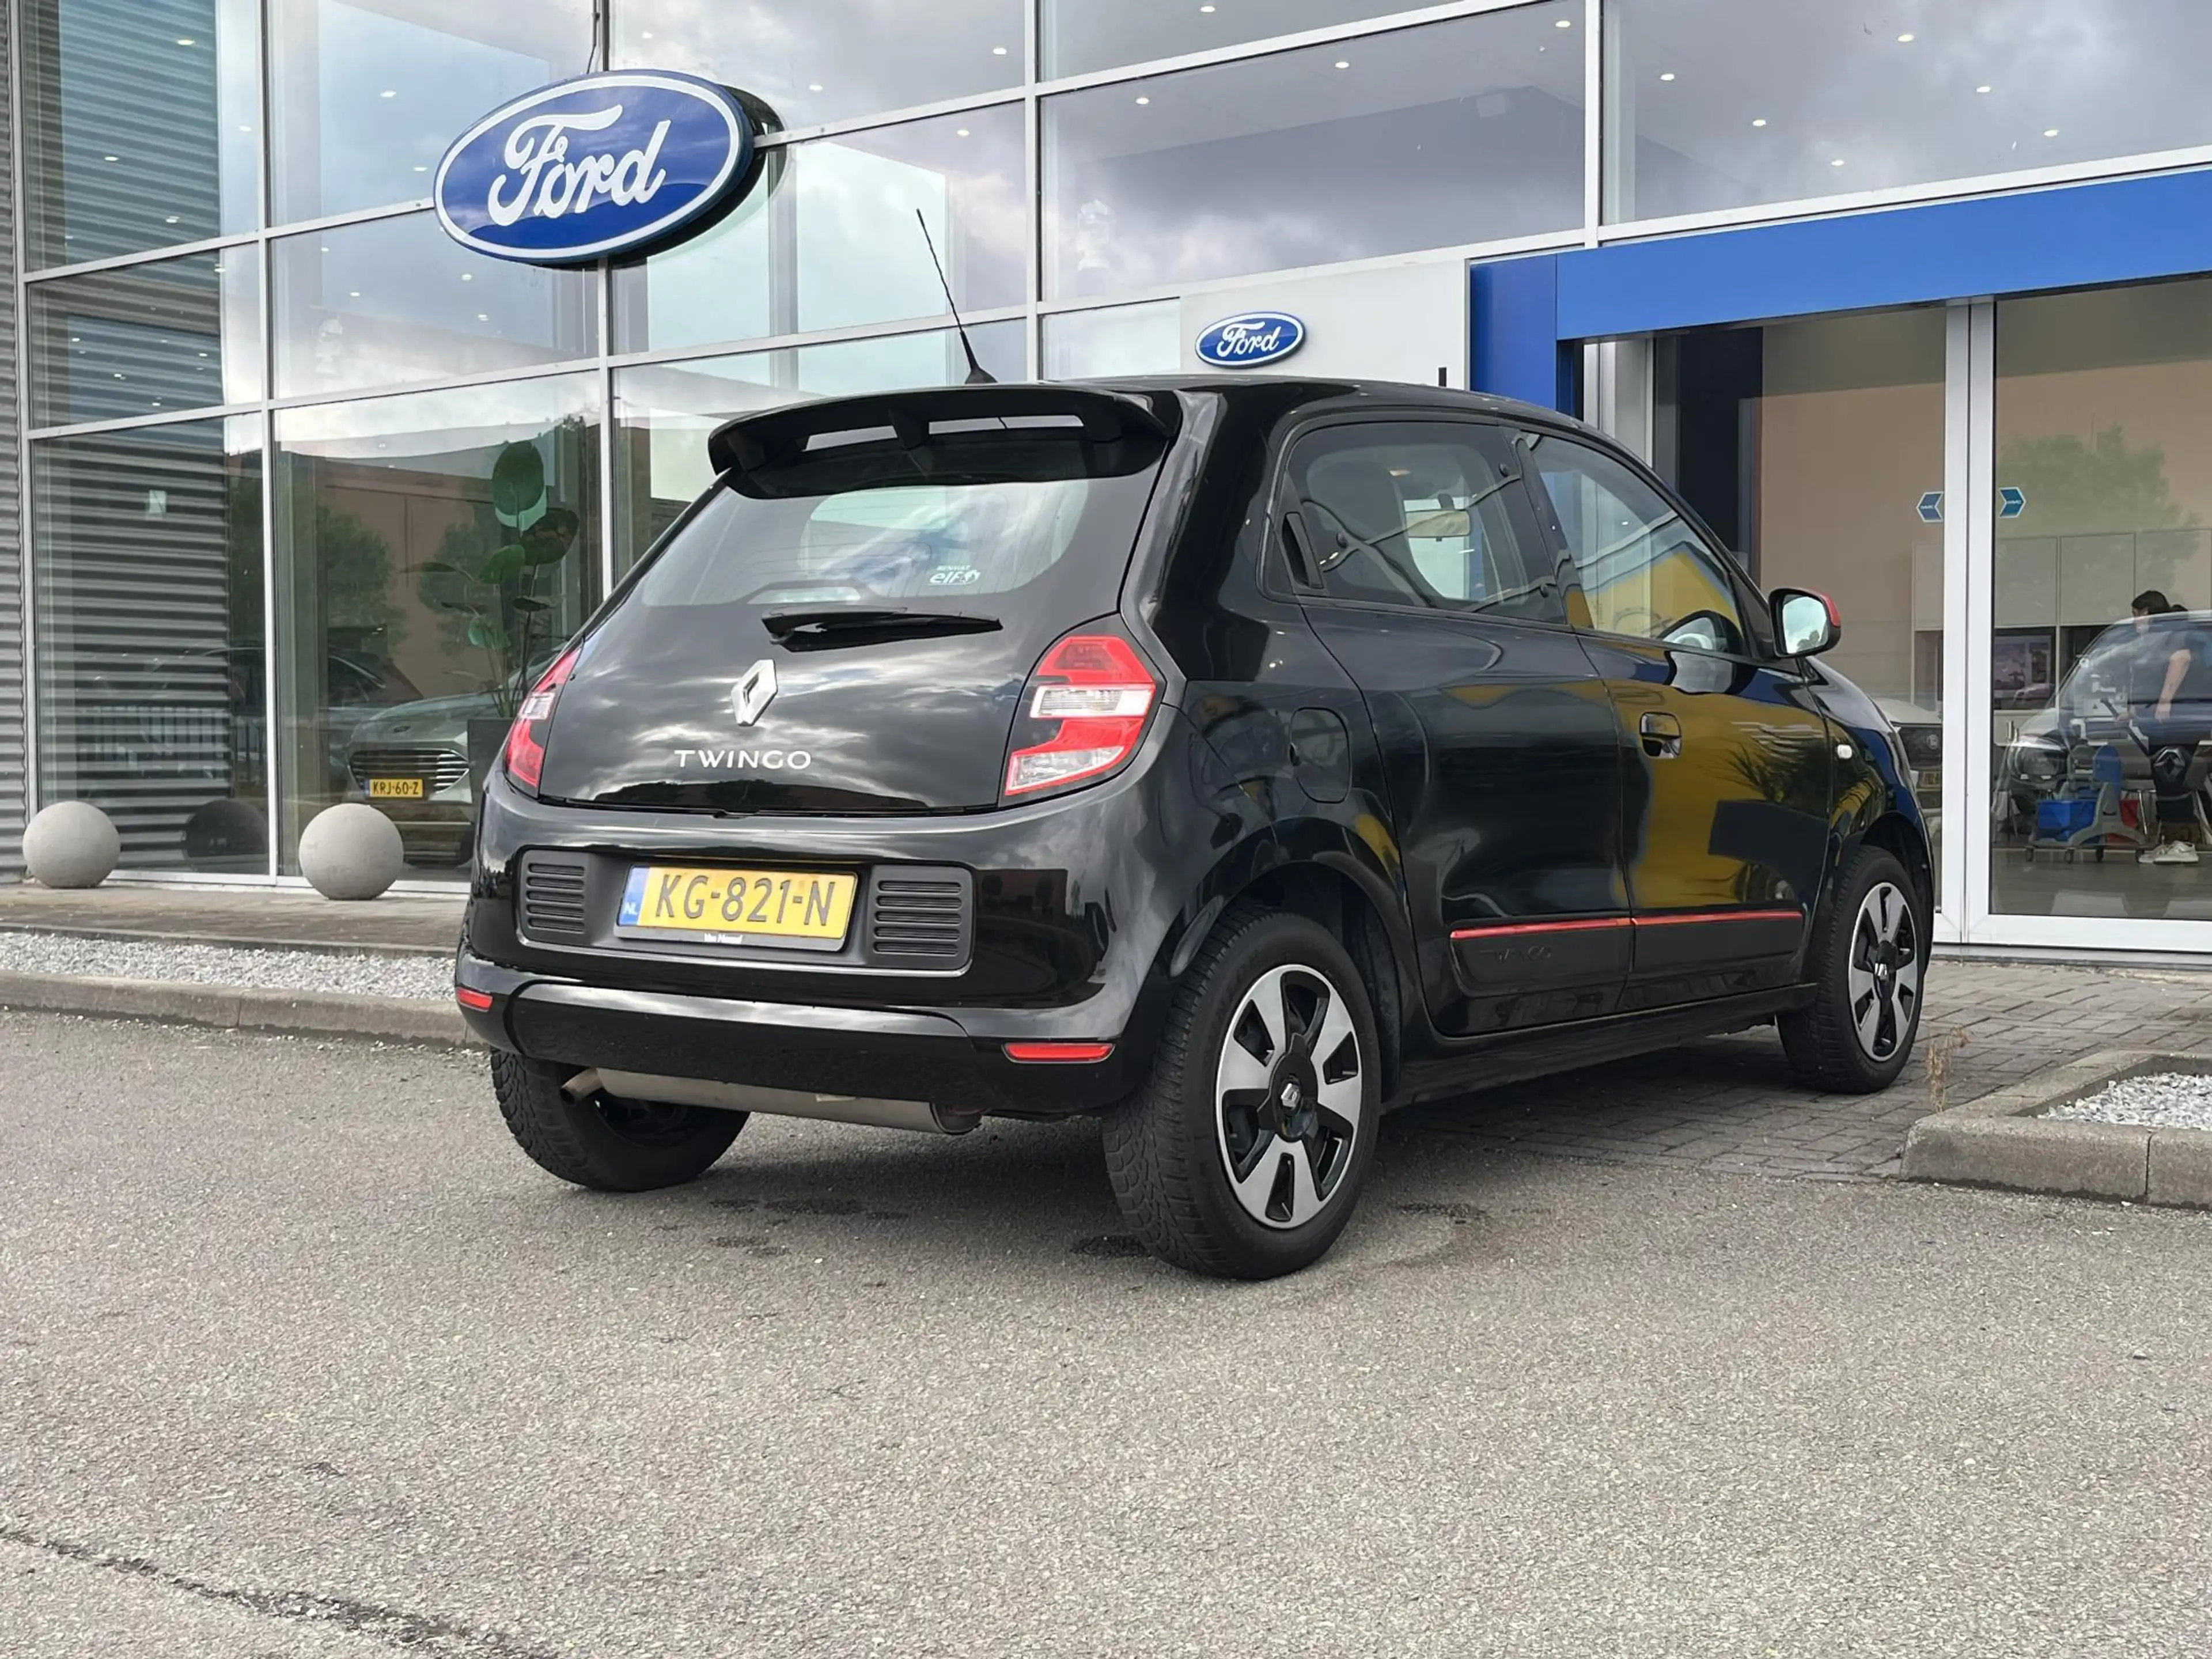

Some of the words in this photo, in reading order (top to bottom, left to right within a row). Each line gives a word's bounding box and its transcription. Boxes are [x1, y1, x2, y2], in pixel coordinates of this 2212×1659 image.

[487, 104, 672, 226] Ford
[1217, 321, 1281, 357] Ford
[674, 749, 812, 769] TWINGO
[373, 781, 419, 795] KRJ-60-Z
[622, 902, 638, 915] NL
[655, 873, 836, 927] KG-821-N
